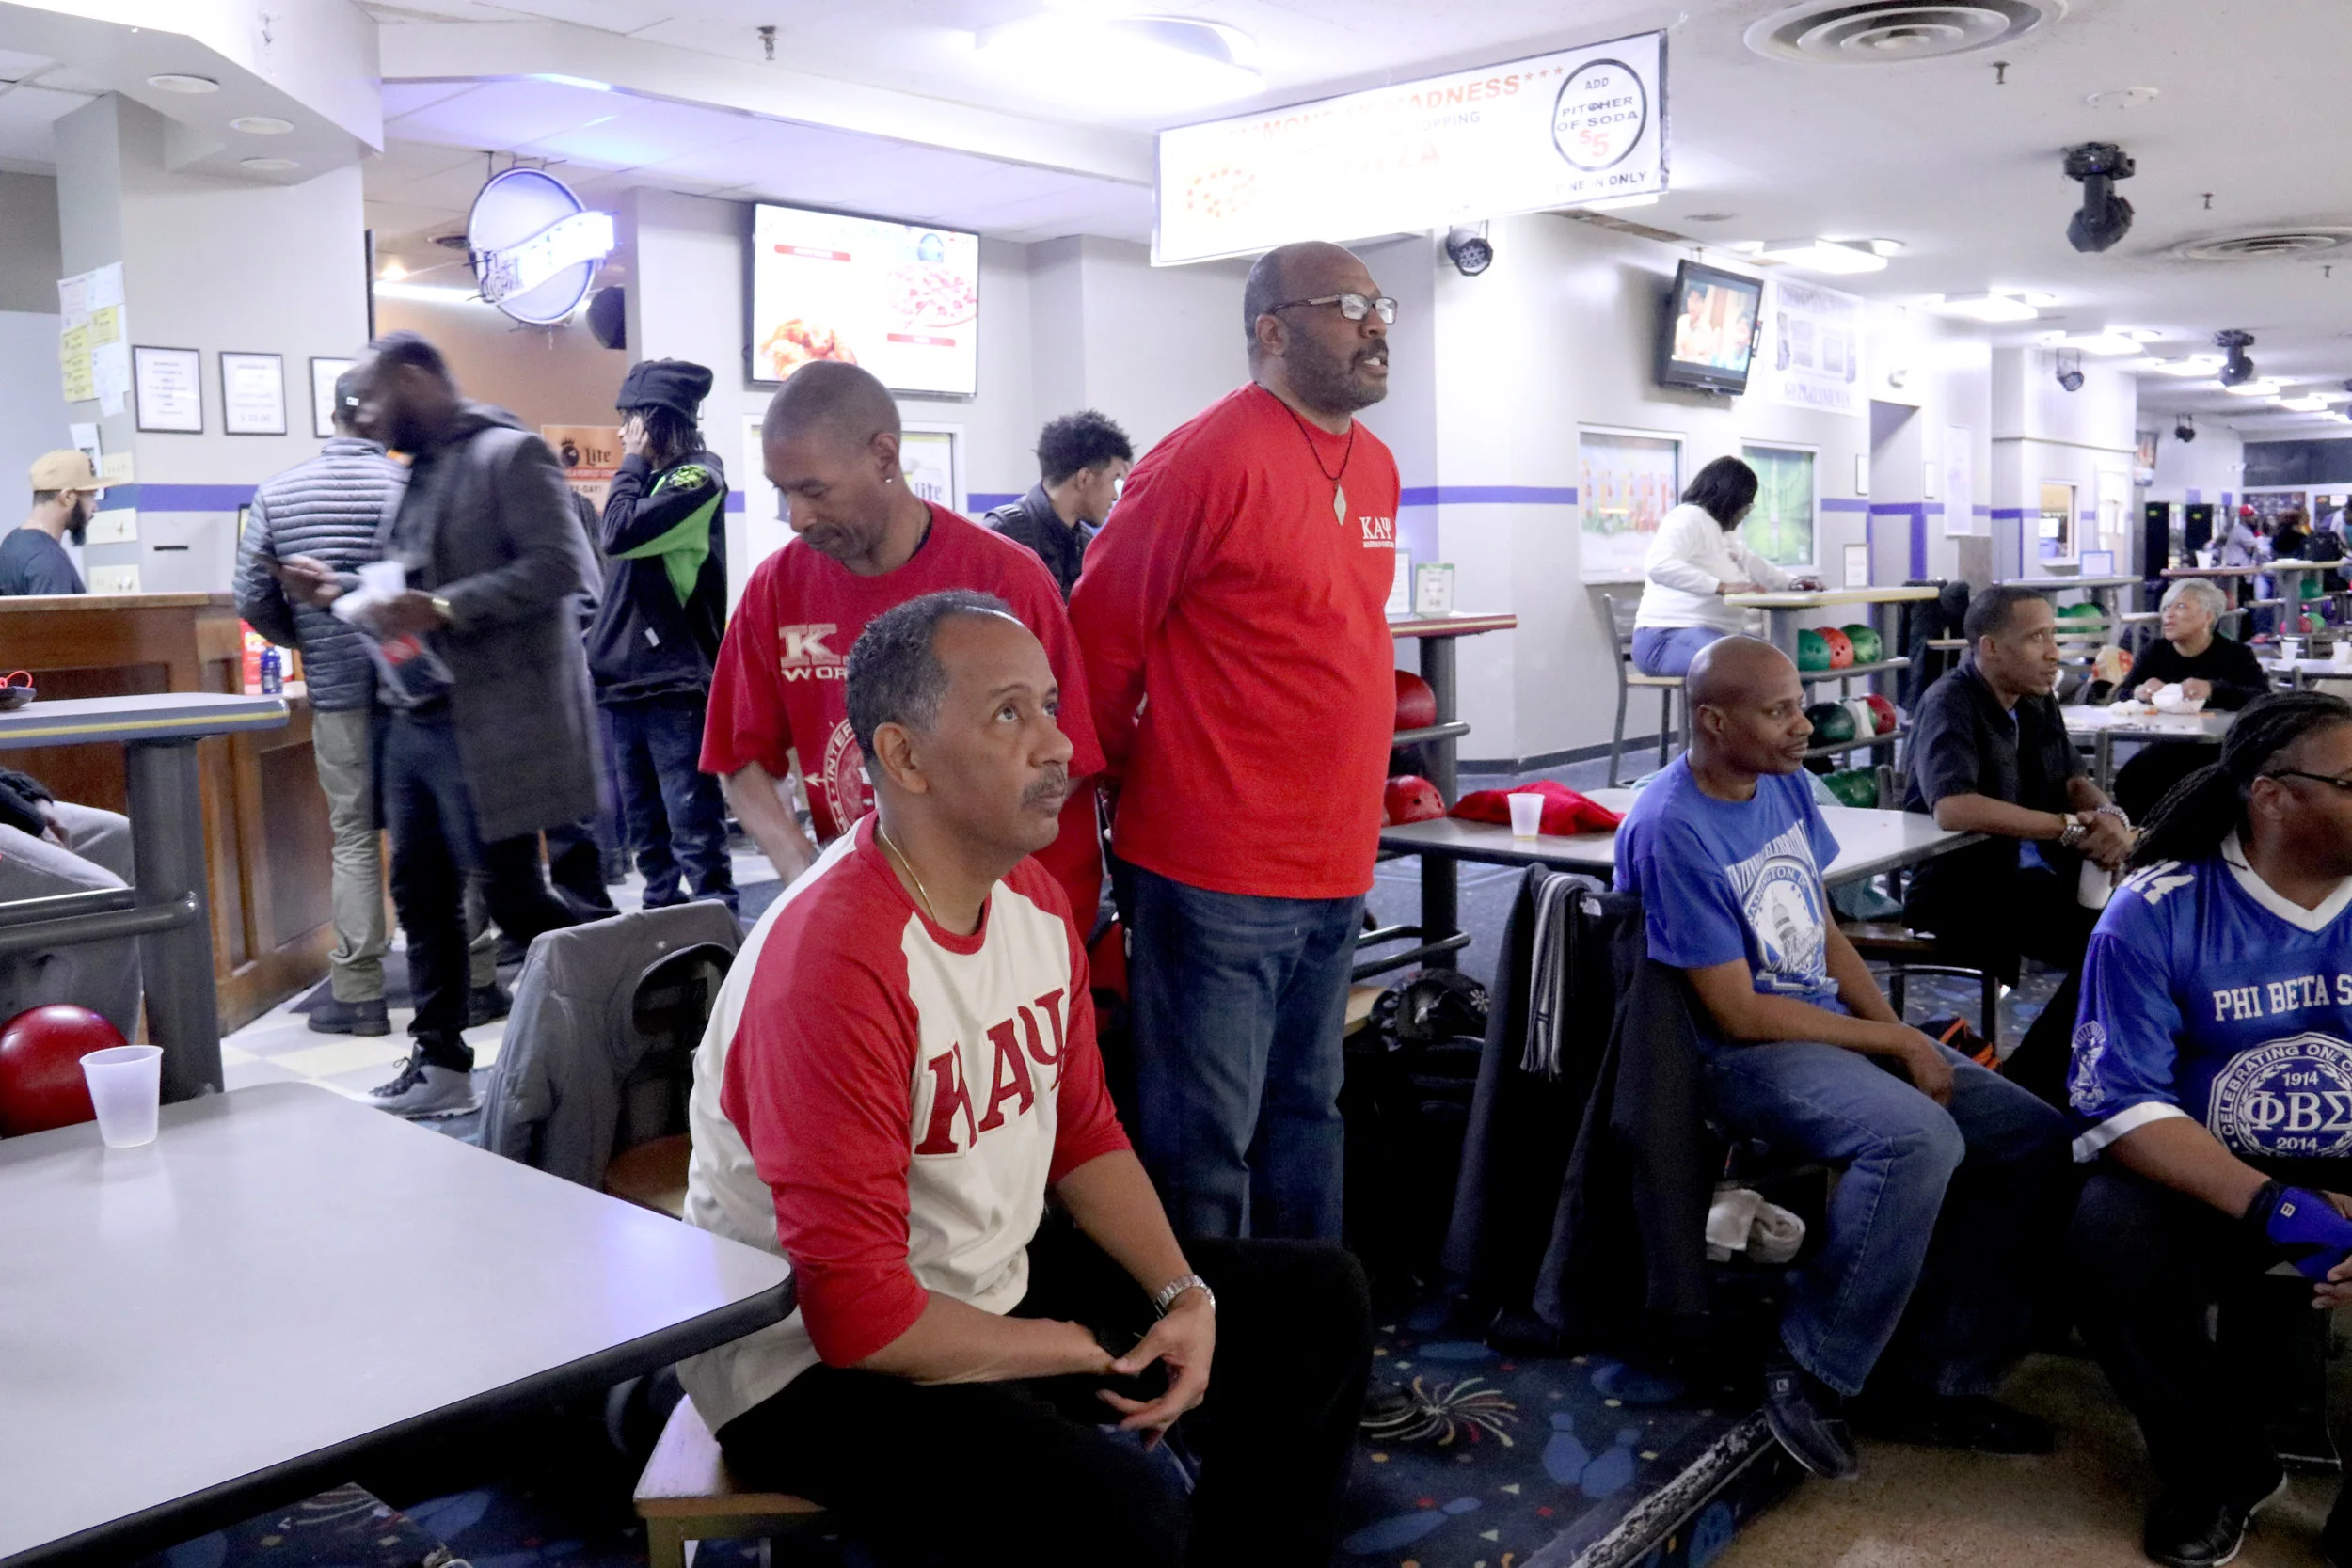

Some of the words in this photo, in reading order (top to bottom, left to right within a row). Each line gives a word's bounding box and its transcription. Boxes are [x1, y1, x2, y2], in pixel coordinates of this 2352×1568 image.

[1584, 77, 1610, 91] ADD
[1411, 110, 1481, 135] OPPING
[1556, 120, 1581, 133] OF
[1587, 109, 1639, 128] SODA
[1579, 128, 1610, 158] $5
[1609, 170, 1647, 186] ONLY
[584, 447, 611, 467] Lite
[2213, 986, 2264, 1022] PHI
[2267, 974, 2330, 1015] BETA
[2336, 974, 2352, 1006] S
[2281, 1071, 2319, 1086] 1914
[2219, 1045, 2300, 1136] CELEBRATING
[2306, 1044, 2343, 1063] ONE
[2276, 1137, 2318, 1150] 2014
